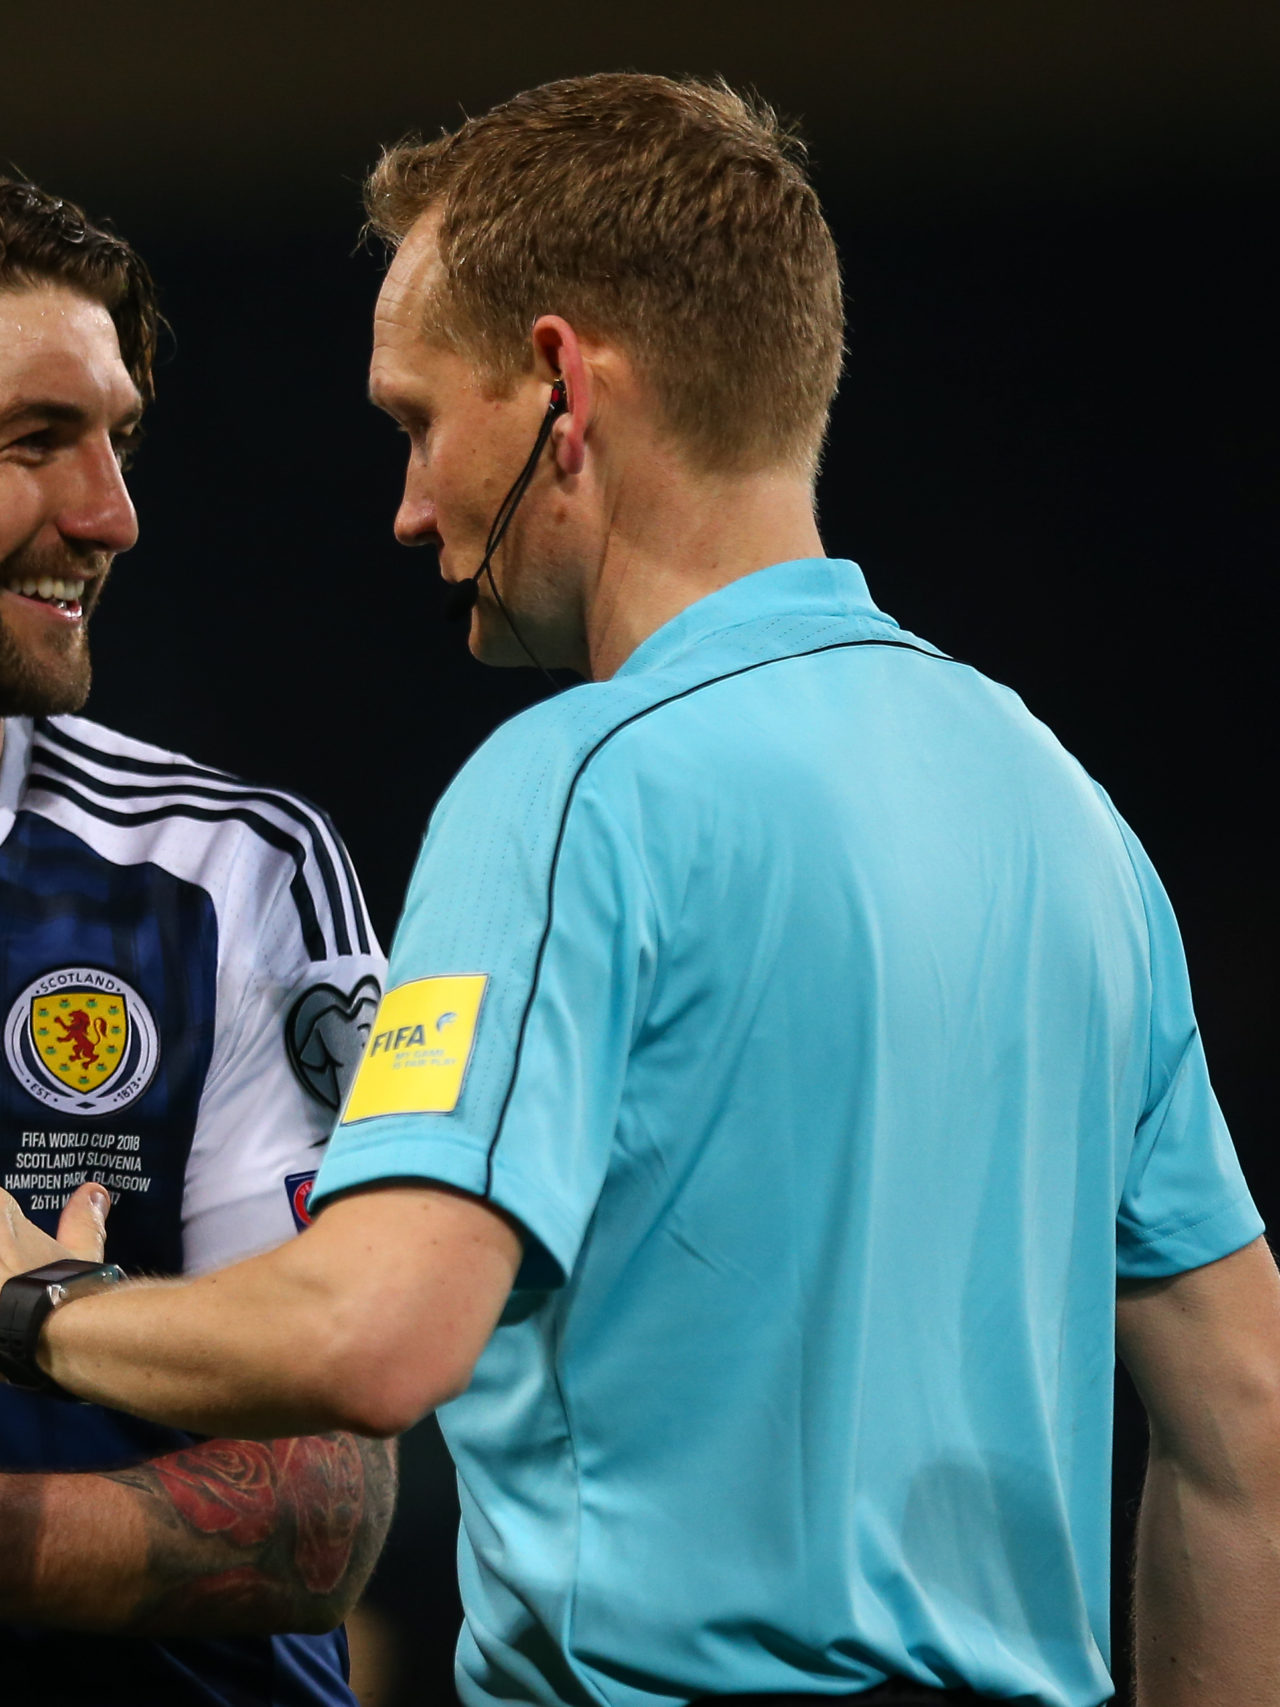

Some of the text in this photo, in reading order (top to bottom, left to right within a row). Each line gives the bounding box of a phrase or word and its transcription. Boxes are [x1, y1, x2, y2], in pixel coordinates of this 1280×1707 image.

[40, 973, 115, 993] SCOTLAND
[370, 1024, 425, 1057] FIFA
[30, 1081, 140, 1101] EST 1873
[22, 1132, 140, 1151] FIFA WORLD CUP 2018
[16, 1152, 142, 1171] SCOTLAND V SLOVENIA
[5, 1174, 61, 1190] HAMPDEN
[92, 1170, 151, 1192] GLASGOW
[31, 1195, 60, 1210] 26TH
